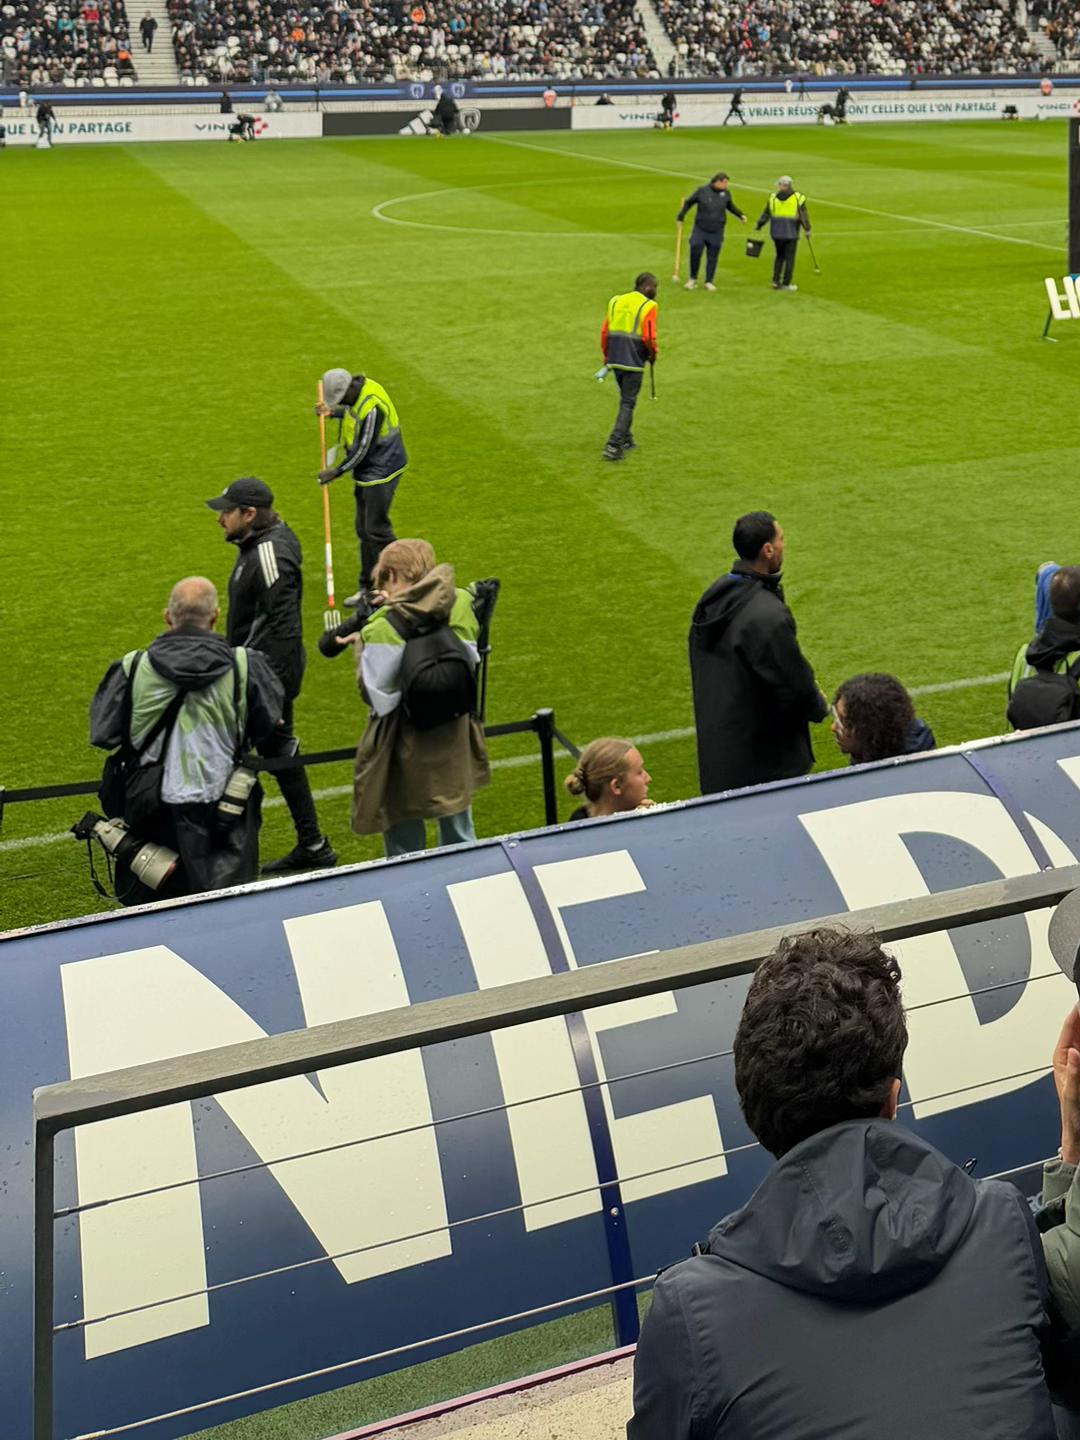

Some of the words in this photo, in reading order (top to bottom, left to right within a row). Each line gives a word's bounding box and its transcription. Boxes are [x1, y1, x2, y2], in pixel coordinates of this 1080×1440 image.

[748, 107, 785, 117] VRAIES
[847, 105, 869, 115] ONT
[871, 104, 905, 114] CELLES
[907, 103, 927, 114] QUE
[954, 102, 997, 112] PARTAGE
[1036, 103, 1071, 111] VINCI
[618, 112, 658, 121] VINC
[6, 123, 26, 135] UE
[68, 121, 133, 134] PARTAGE
